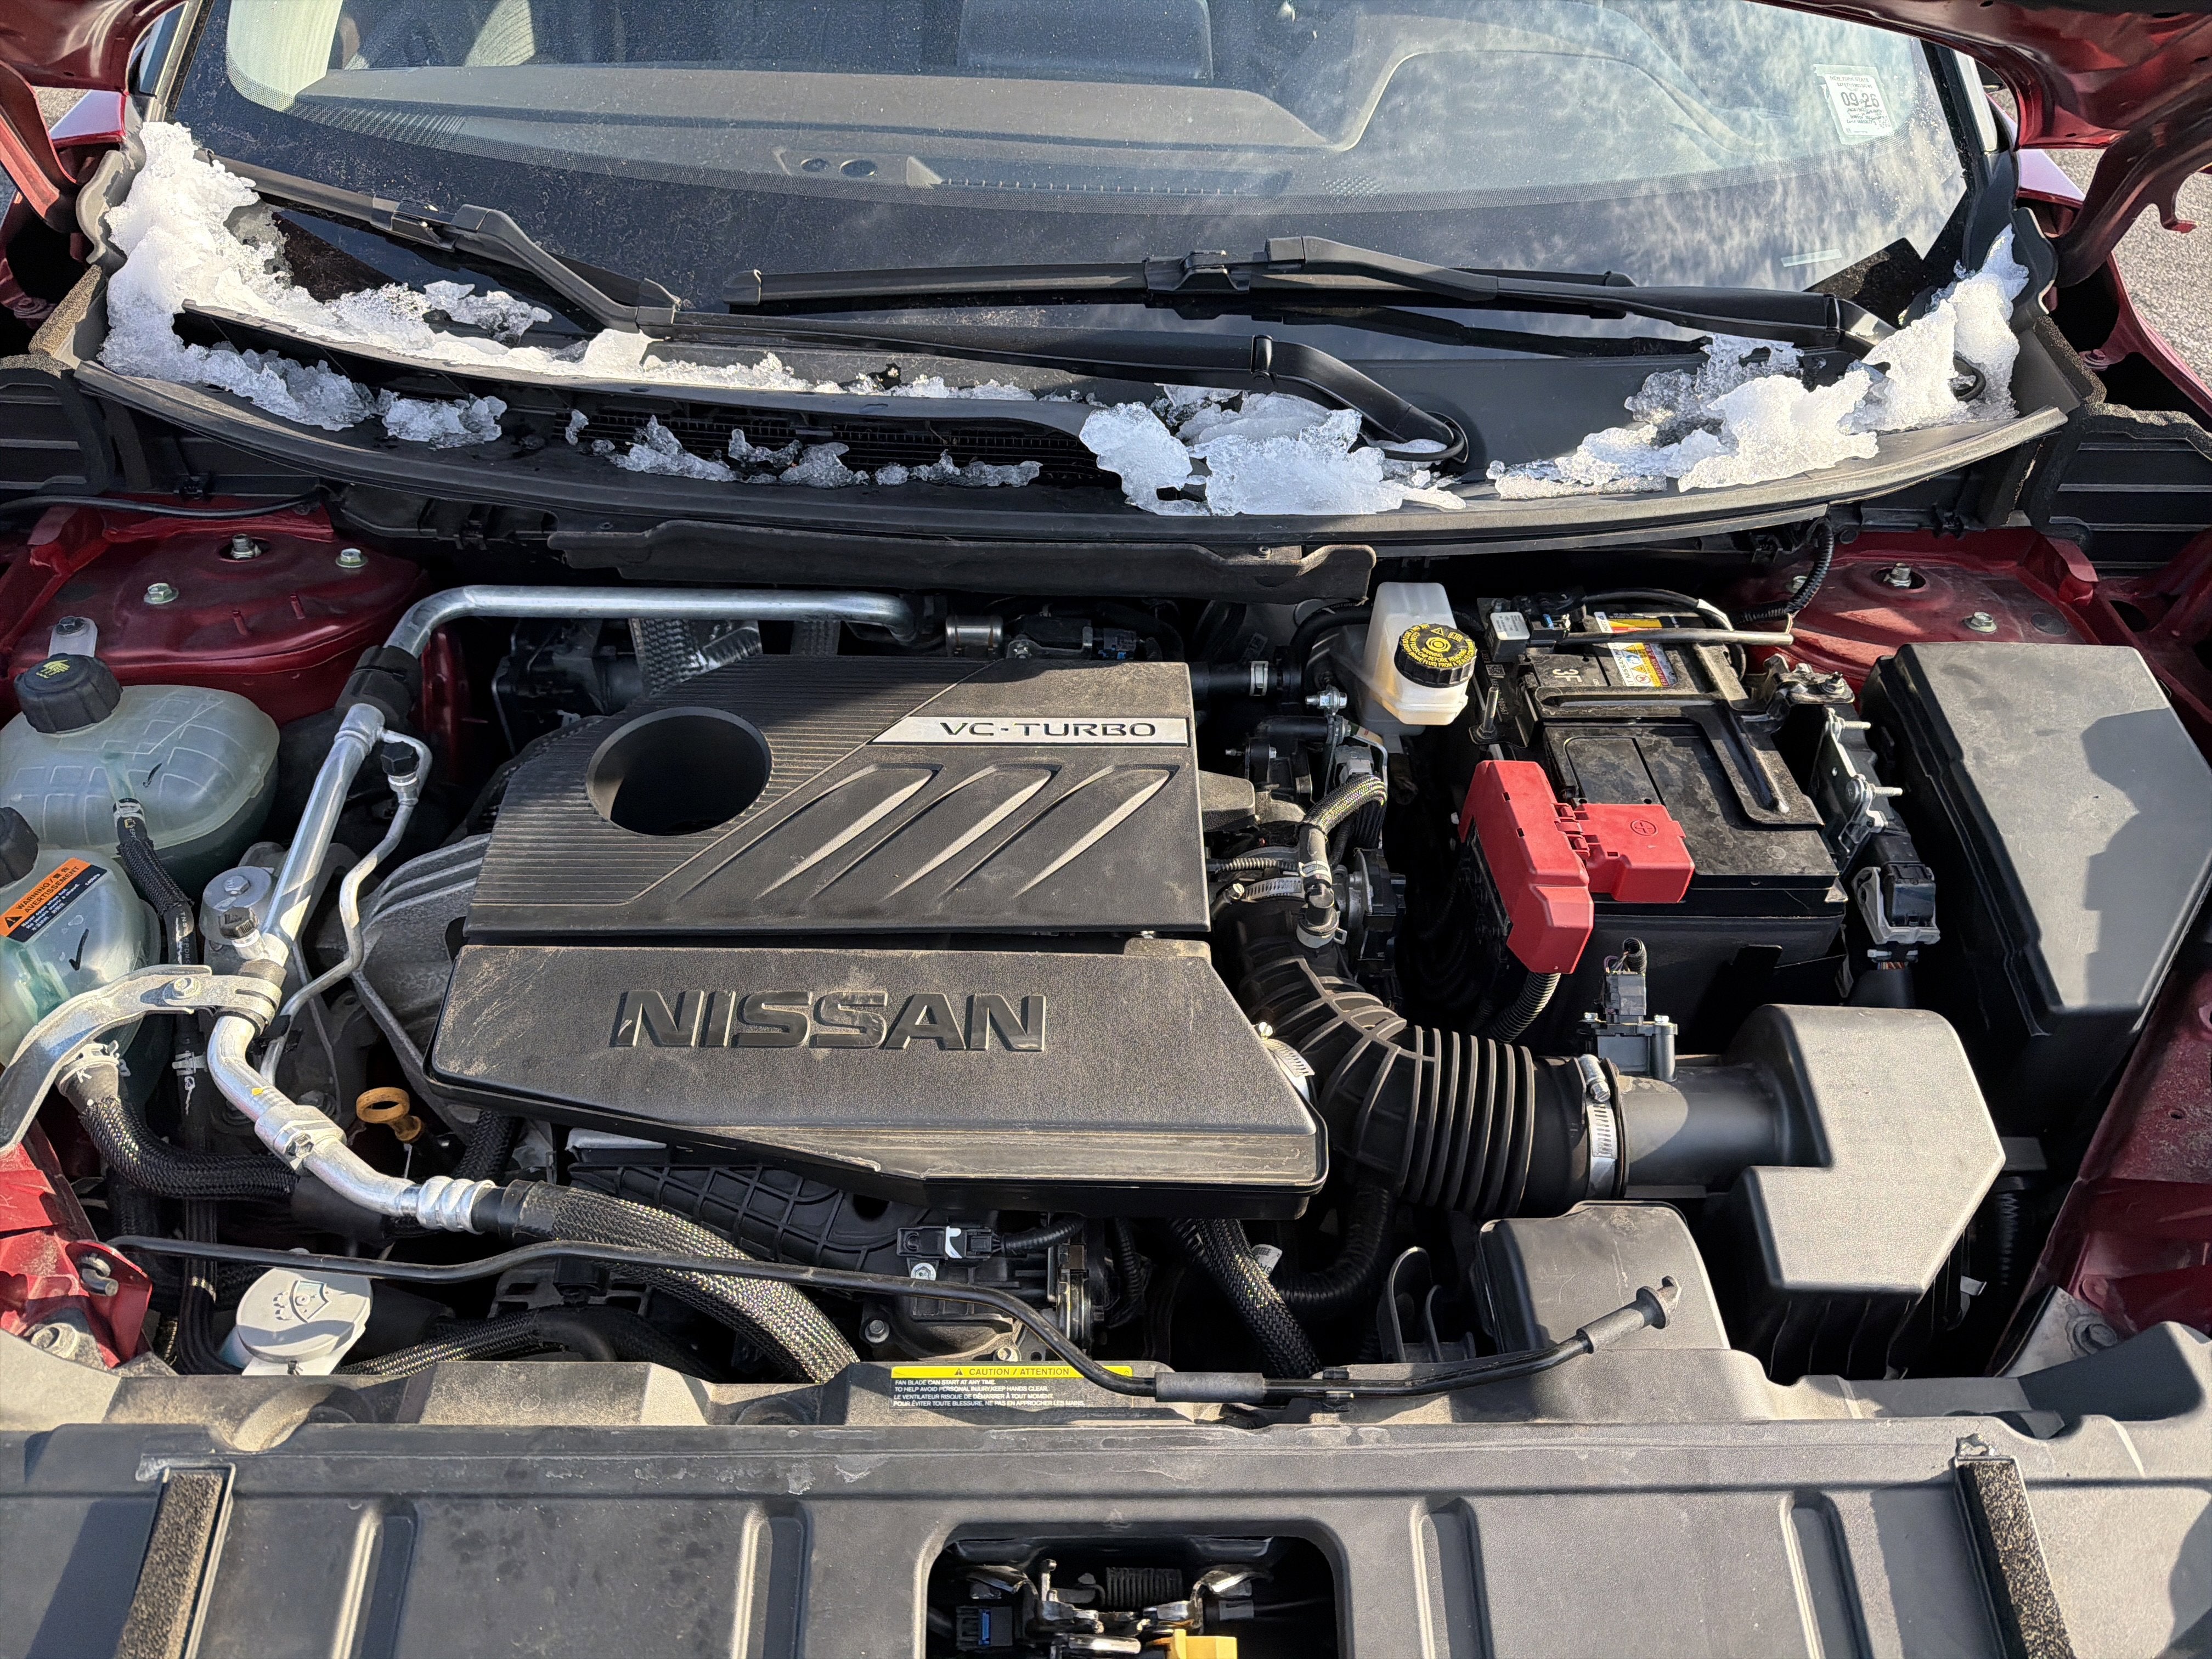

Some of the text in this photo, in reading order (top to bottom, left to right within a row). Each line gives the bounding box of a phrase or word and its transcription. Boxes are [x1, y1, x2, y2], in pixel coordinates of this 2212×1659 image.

[939, 723, 1156, 737] VC-TURBO
[16, 882, 50, 910] WARNING
[24, 866, 80, 913] AVERTISSEMENT
[610, 990, 1046, 1052] NISSAN
